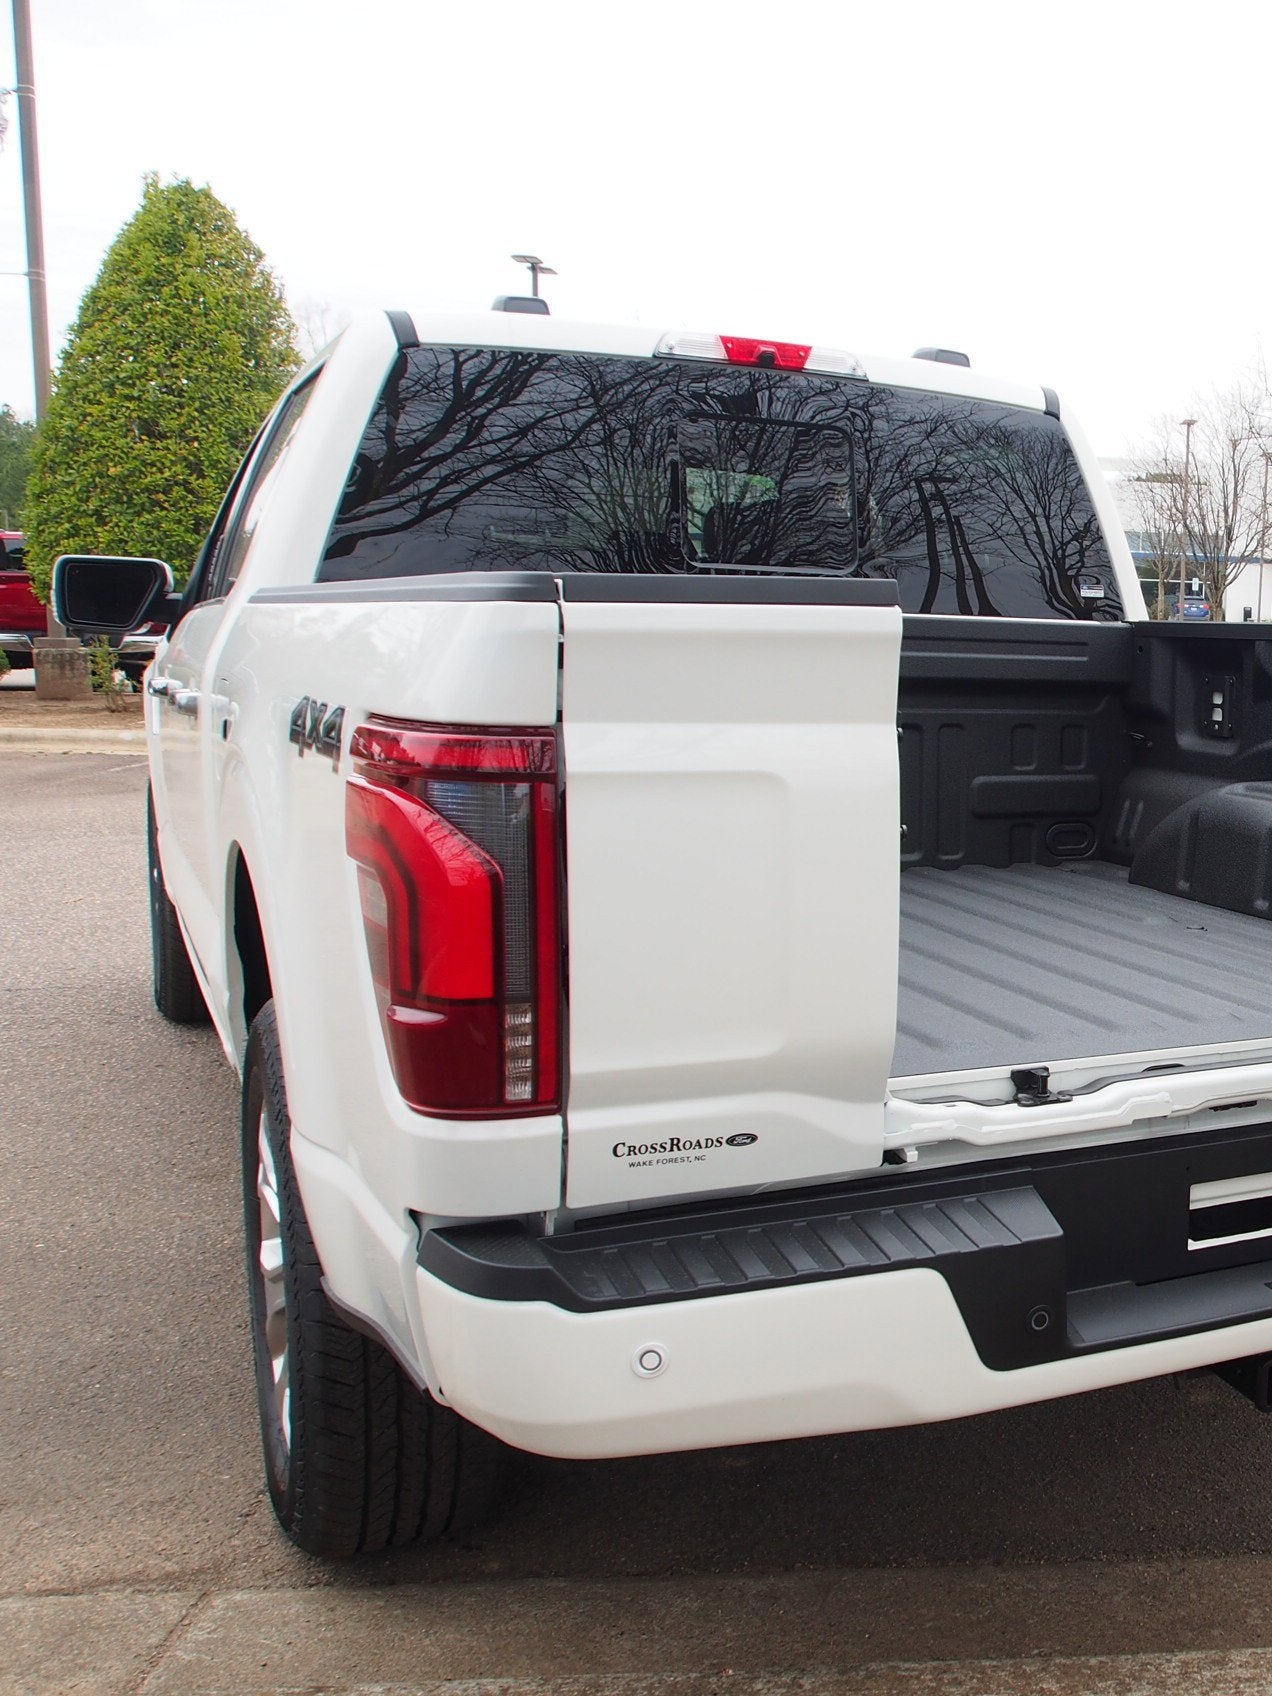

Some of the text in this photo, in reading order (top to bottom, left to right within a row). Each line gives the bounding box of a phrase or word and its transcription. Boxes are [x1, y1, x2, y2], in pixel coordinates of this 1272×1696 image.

[628, 1154, 706, 1168] WAKE FOREST, NC
